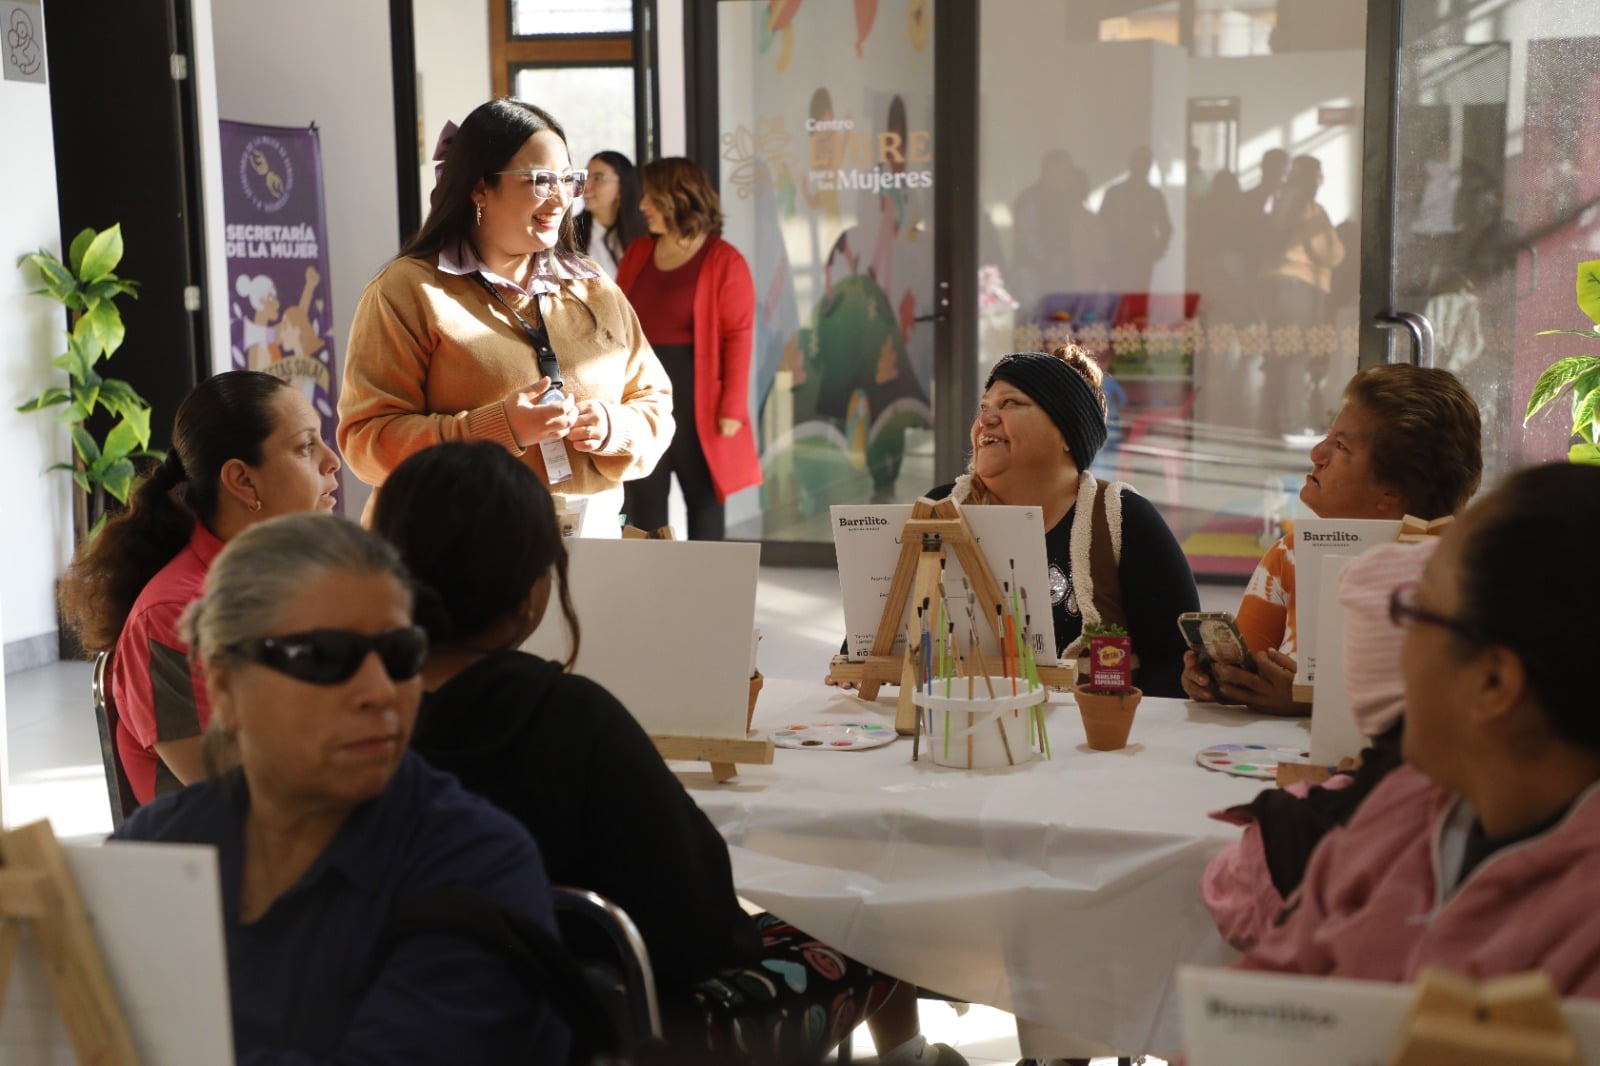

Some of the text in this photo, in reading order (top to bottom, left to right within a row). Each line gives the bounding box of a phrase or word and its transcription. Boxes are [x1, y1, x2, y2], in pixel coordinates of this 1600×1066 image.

[806, 118, 854, 131] Centro
[810, 131, 933, 166] LIBRE
[836, 166, 933, 194] Mujeres
[226, 223, 316, 241] SECRETARÍA
[226, 242, 319, 259] DE LA MUJER
[839, 516, 888, 527] Barrilito
[1303, 531, 1360, 542] Barrilito
